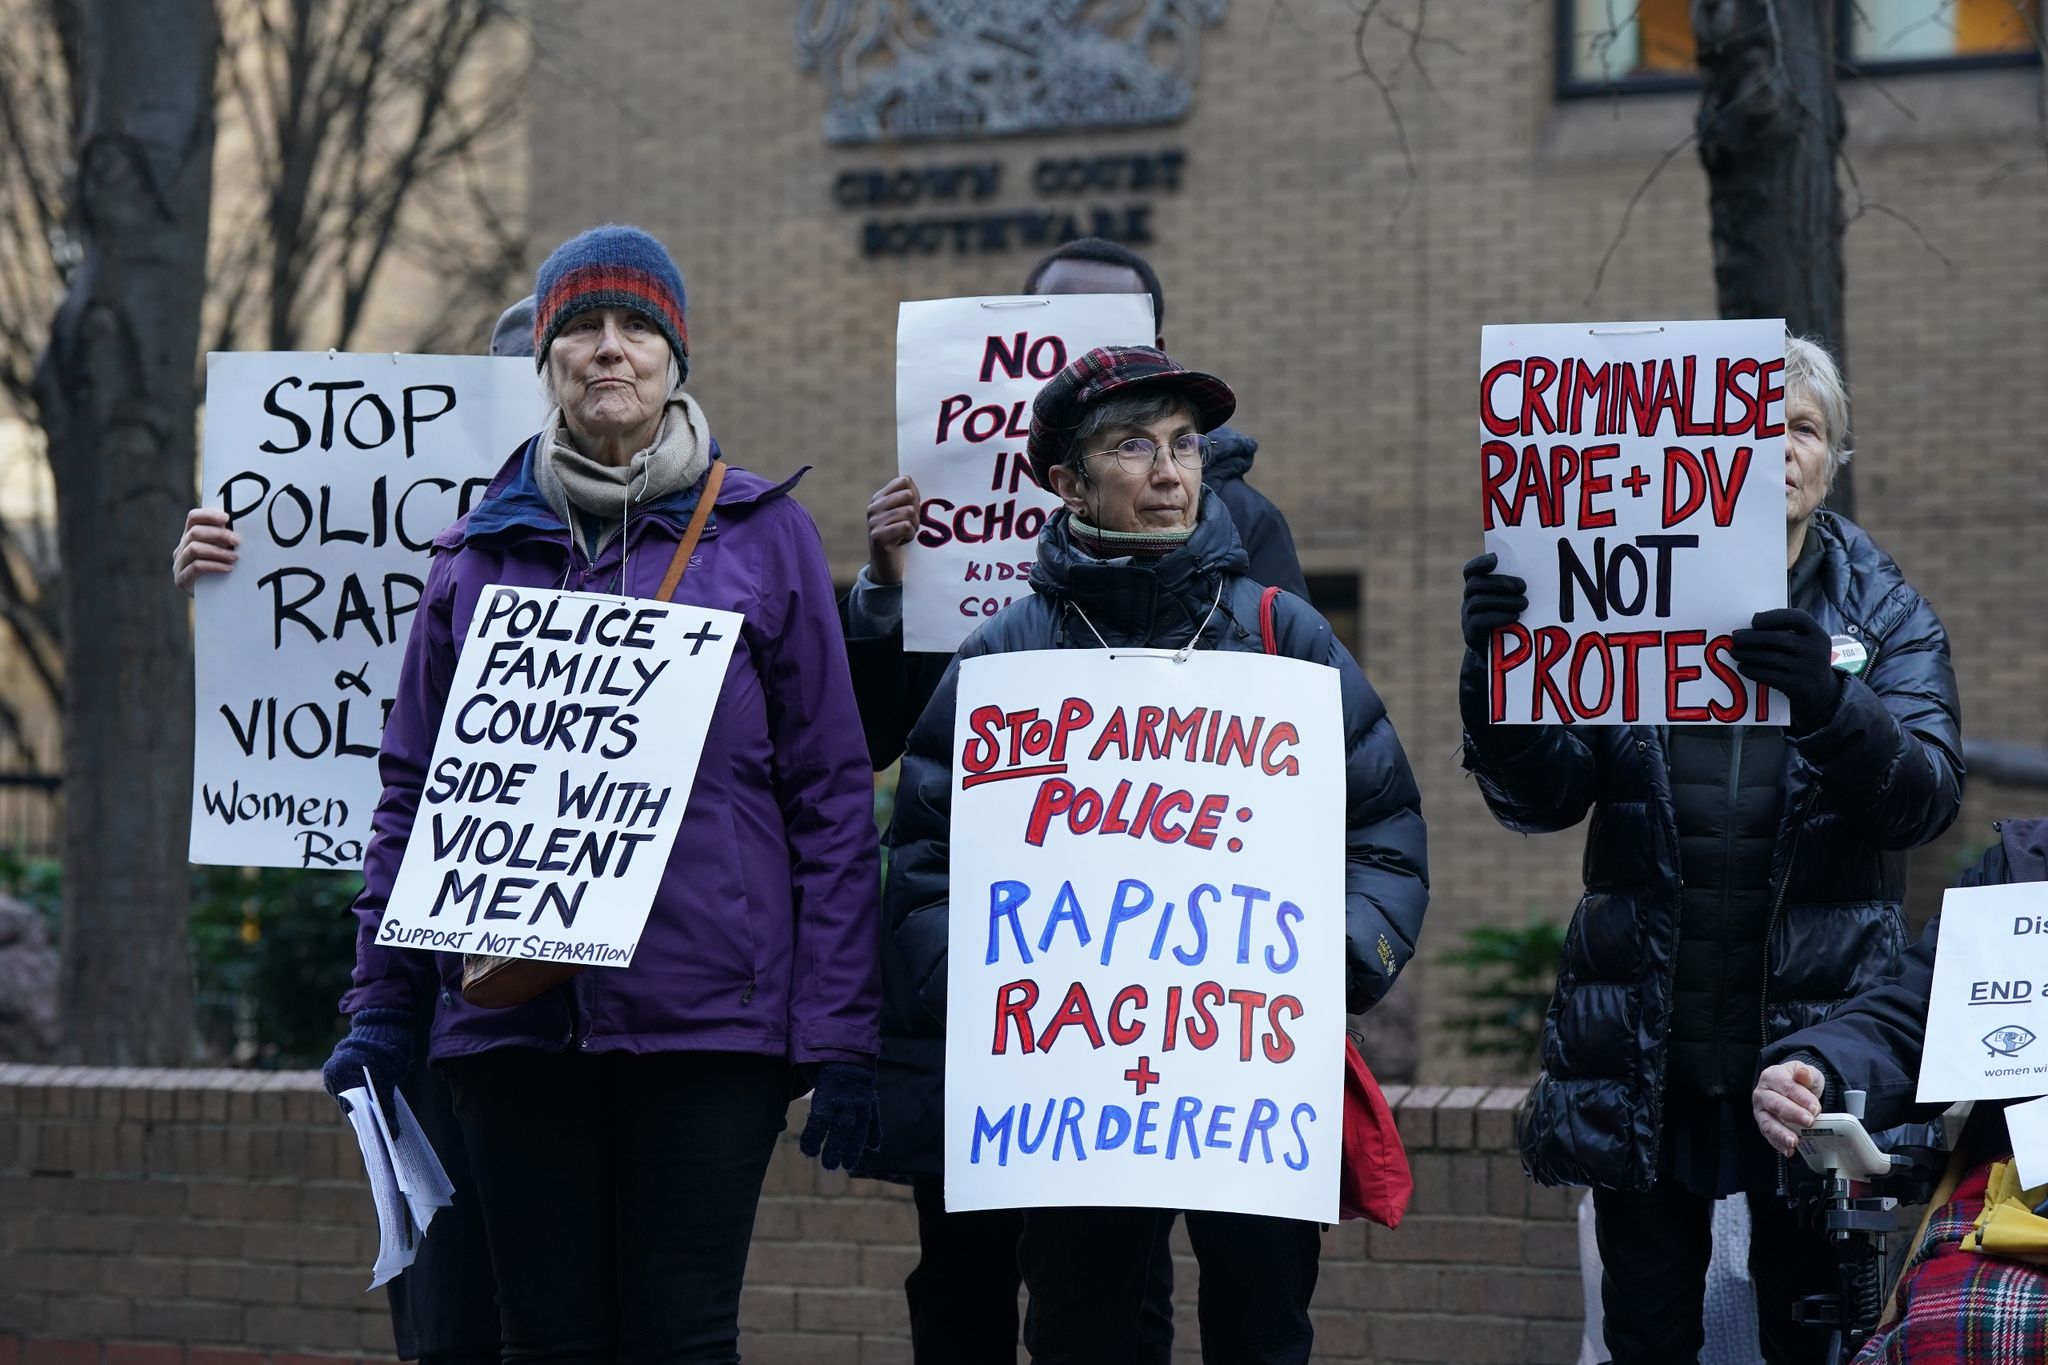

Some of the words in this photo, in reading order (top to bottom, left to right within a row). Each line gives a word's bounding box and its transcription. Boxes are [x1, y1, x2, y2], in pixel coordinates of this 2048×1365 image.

[833, 162, 1003, 210] CROWN
[1031, 147, 1187, 193] COURT
[979, 331, 1067, 382] NO
[259, 376, 457, 459] STOP
[1480, 354, 1785, 440] CRIMINALISE
[1481, 440, 1621, 531] RAPE
[1661, 446, 1754, 530] DV
[916, 498, 1057, 548] SCHO
[1557, 534, 1699, 622] NOT
[477, 588, 669, 649] POLICE
[682, 621, 723, 656] +
[476, 640, 671, 707] FAMILY
[219, 696, 396, 761] VIOL
[454, 693, 640, 760] COURTS
[962, 697, 1094, 774] STOP
[1088, 705, 1300, 777] ARMING
[202, 779, 349, 828] Women
[425, 757, 537, 805] SIDE
[558, 769, 672, 828] WITH
[1024, 777, 1254, 854] POLICE:
[432, 813, 656, 878] VIOLENT
[429, 869, 588, 929] MEN
[984, 878, 1305, 974] RAPISTS
[476, 931, 521, 956] NOT
[991, 979, 1304, 1063] RACISTS
[1970, 980, 2033, 1001] END
[1123, 1055, 1160, 1096] +
[1984, 1067, 2030, 1077] women
[970, 1096, 1317, 1171] MURDERERS
